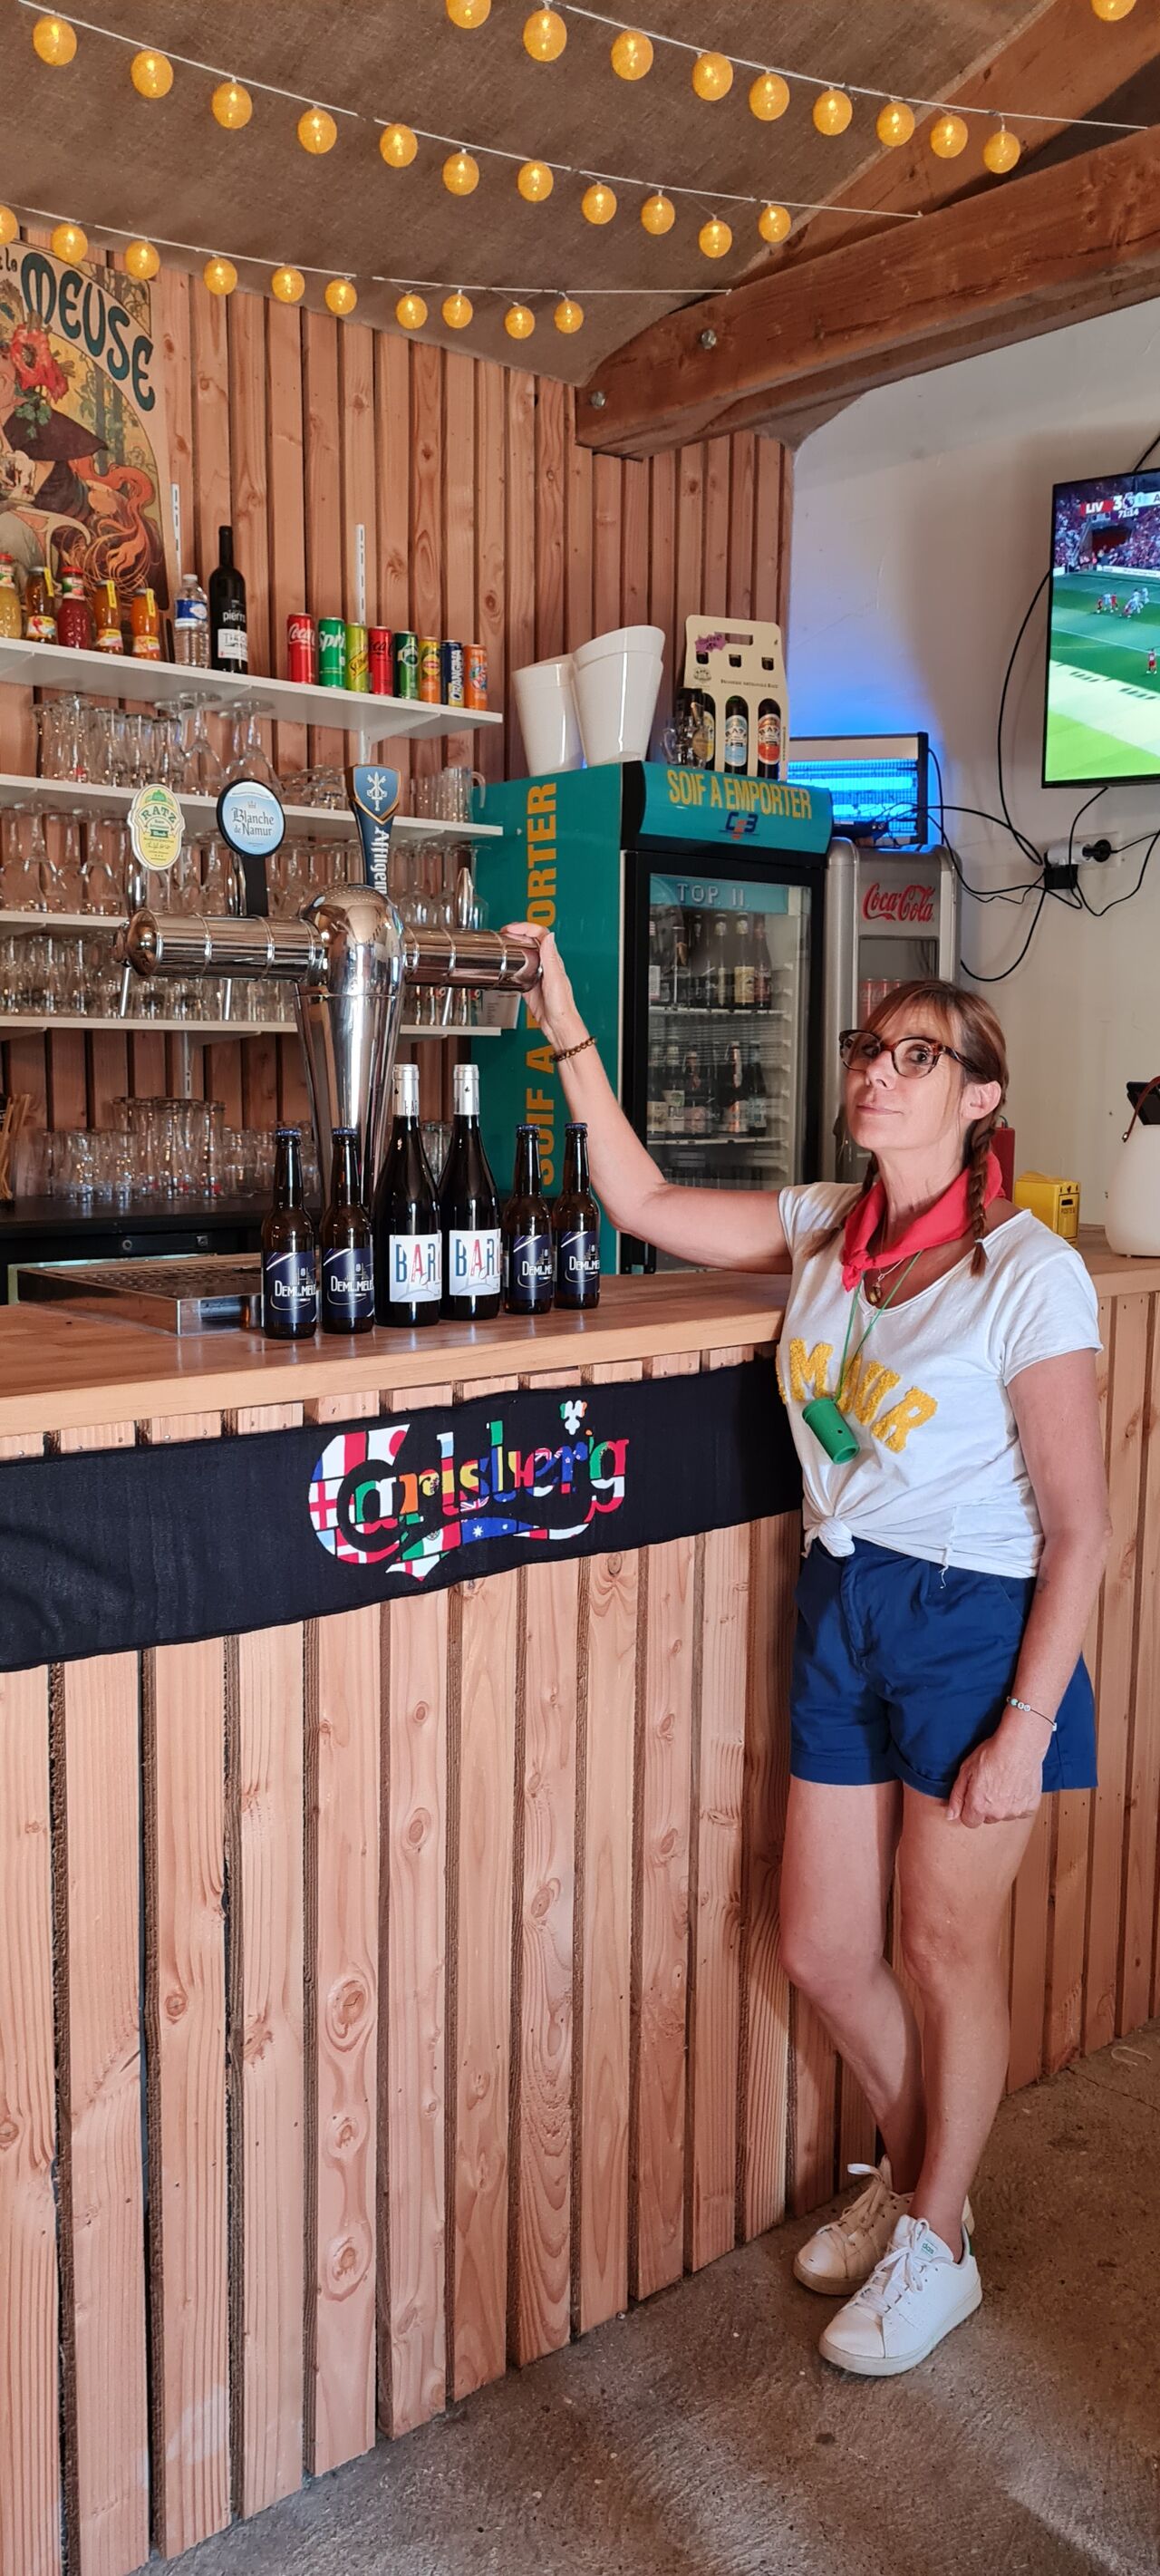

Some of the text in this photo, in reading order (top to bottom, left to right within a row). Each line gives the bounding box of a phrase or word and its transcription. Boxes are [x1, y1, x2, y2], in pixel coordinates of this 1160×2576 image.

[21, 252, 156, 412] MEUSE
[1086, 501, 1103, 514] LIV
[1113, 494, 1123, 511] 3
[1118, 508, 1139, 518] 71:14
[450, 650, 463, 701] ORANGINA
[140, 805, 177, 824] RATZ
[667, 769, 813, 819] SOIF A EMPORTER
[230, 807, 275, 826] Blanche
[234, 822, 273, 837] de Namur
[371, 825, 390, 896] Affligem
[862, 882, 935, 923] Coca-Cola
[526, 1044, 555, 1074] A
[776, 1337, 939, 1454] MOUR
[308, 1419, 630, 1582] Carlsberg
